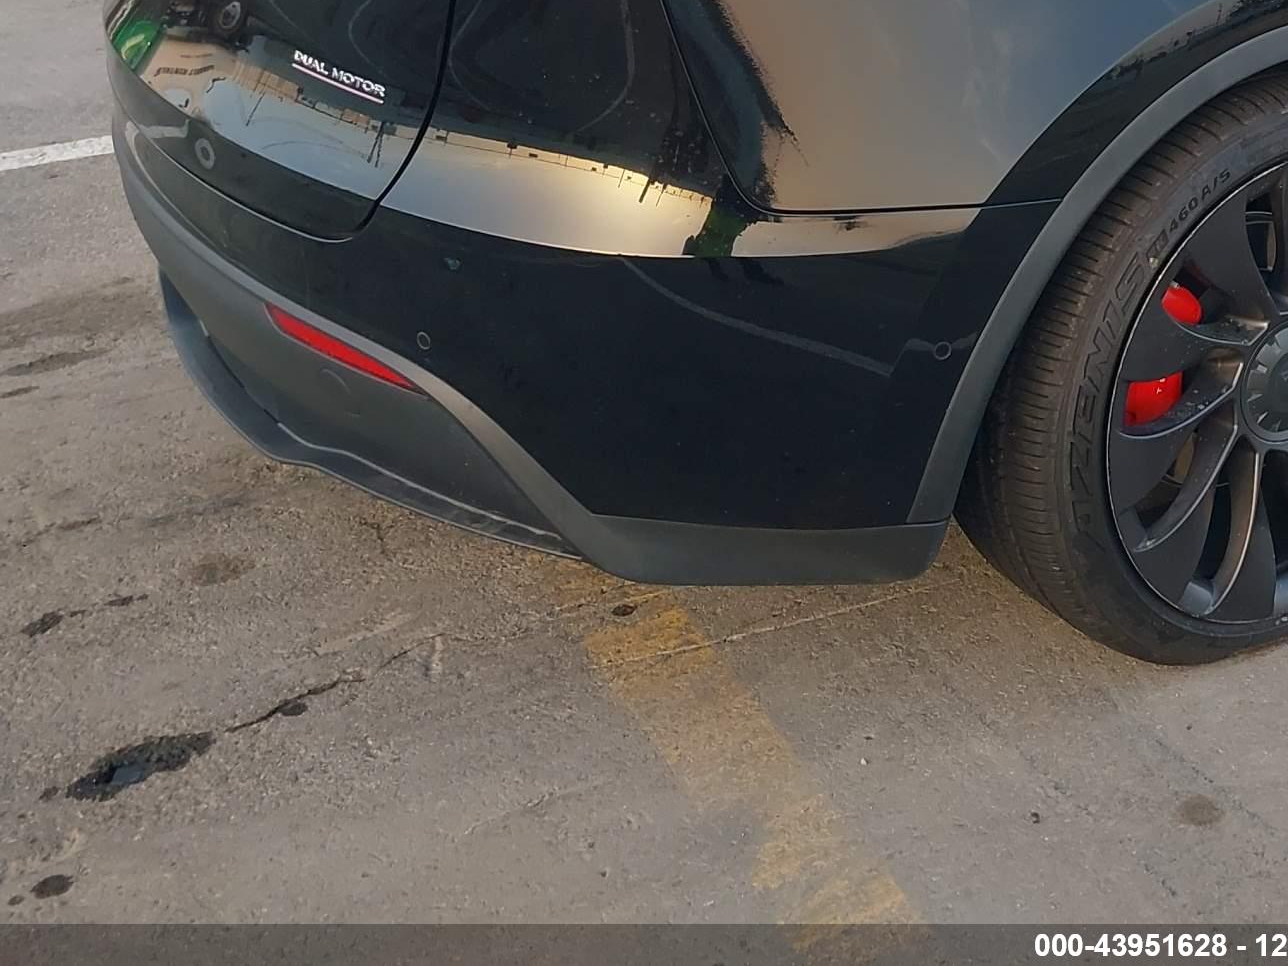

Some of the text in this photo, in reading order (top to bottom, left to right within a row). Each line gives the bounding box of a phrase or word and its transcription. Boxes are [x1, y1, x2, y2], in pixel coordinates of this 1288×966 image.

[293, 49, 386, 97] DUAL MOTOR
[1201, 167, 1232, 201] A/S
